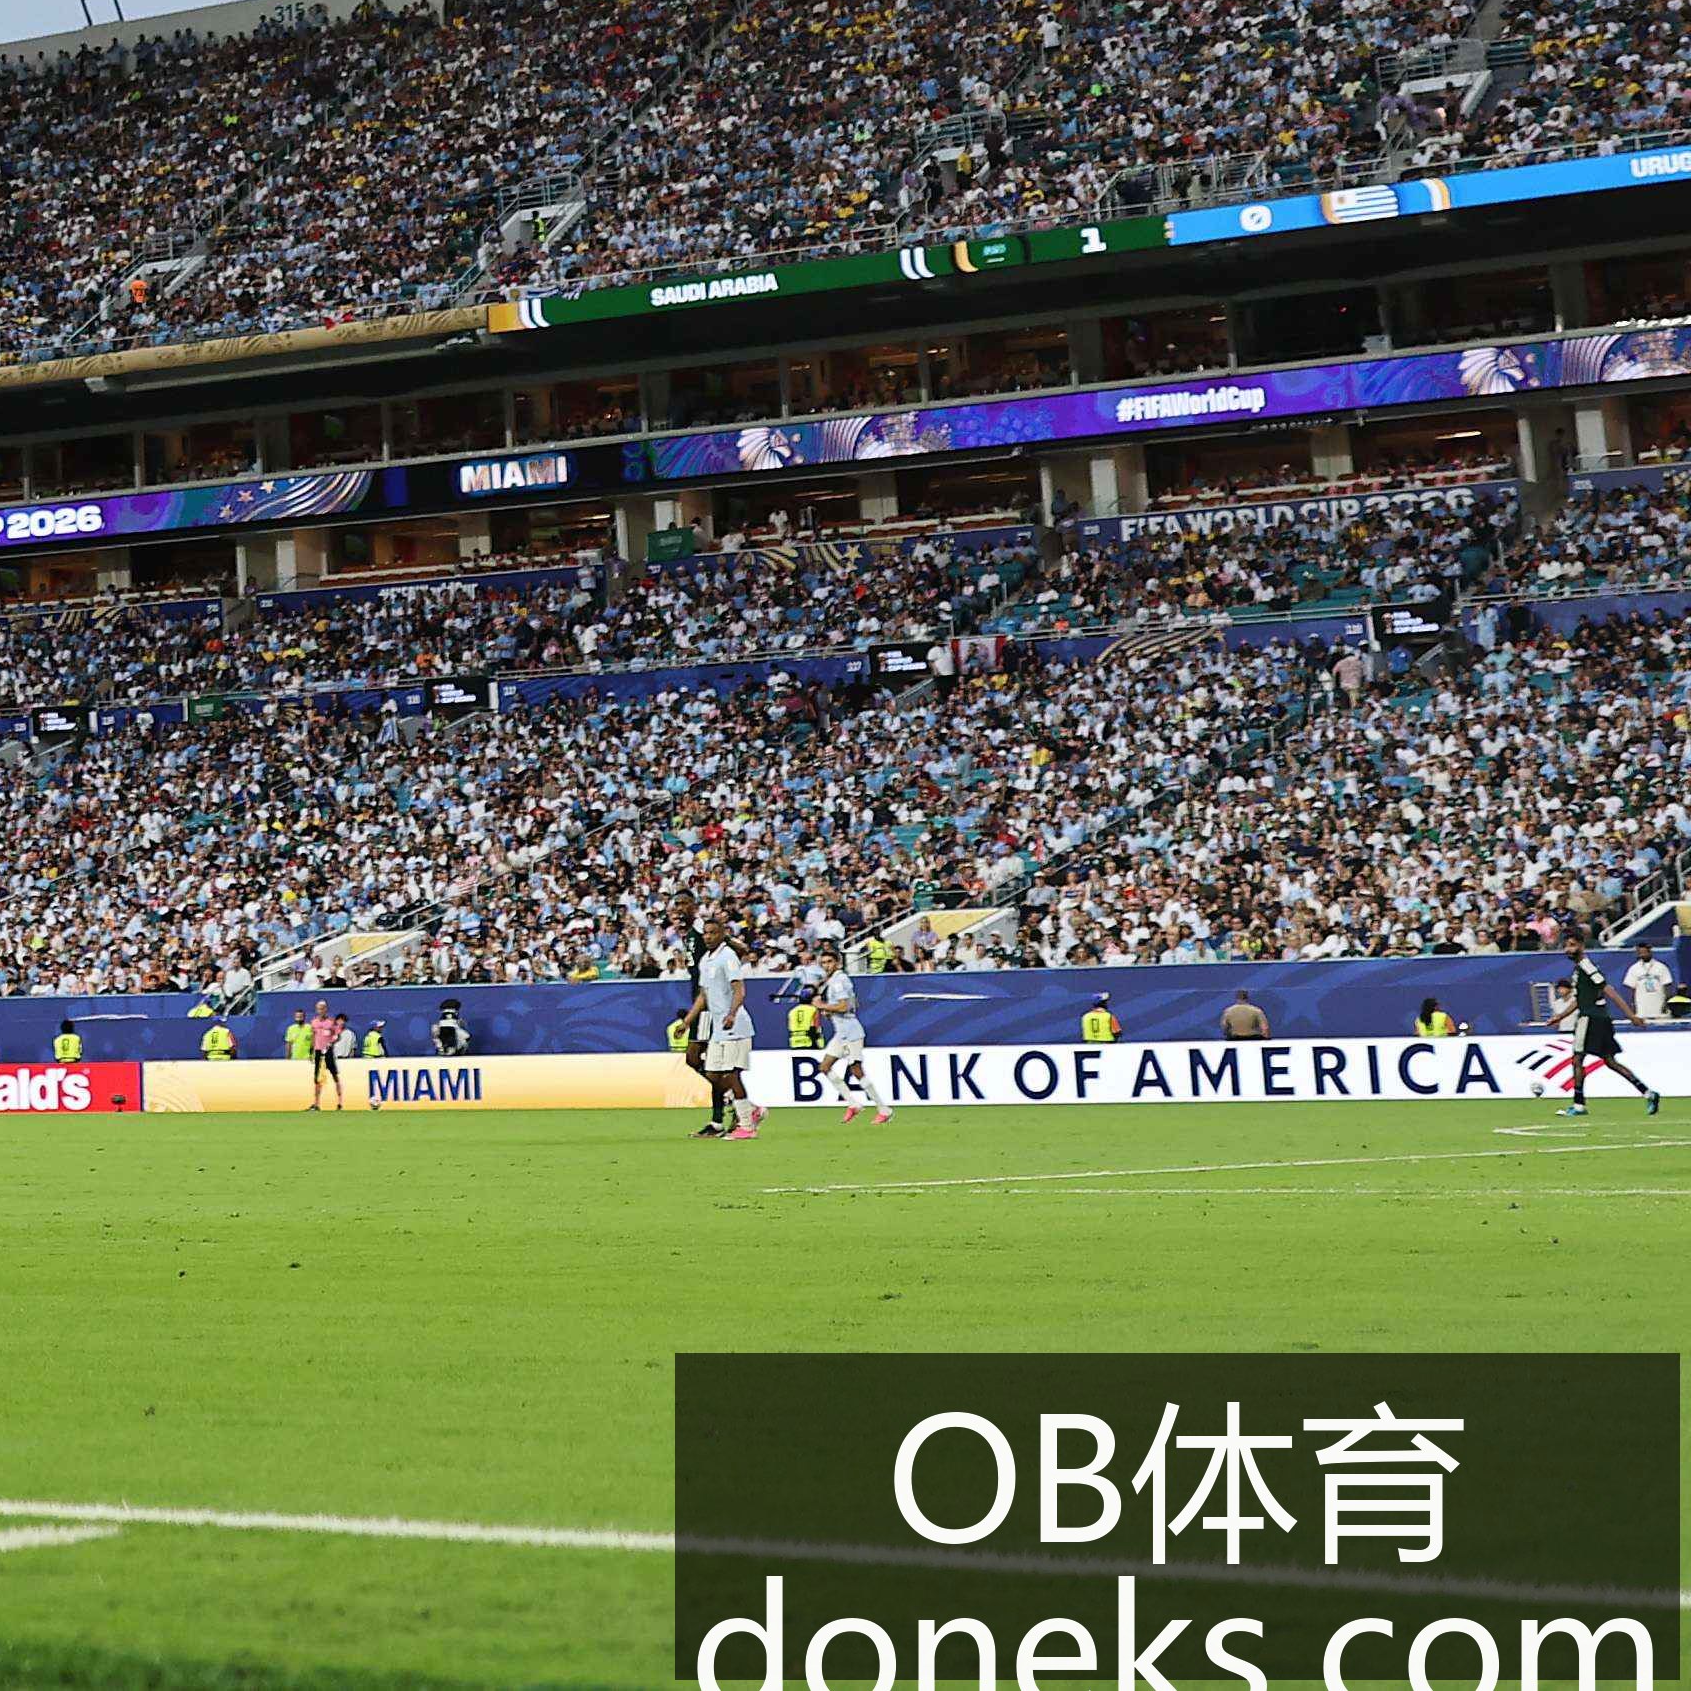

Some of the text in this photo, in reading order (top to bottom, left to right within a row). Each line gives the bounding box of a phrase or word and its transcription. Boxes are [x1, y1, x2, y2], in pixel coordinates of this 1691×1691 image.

[1080, 227, 1107, 254] 1
[650, 272, 779, 308] SAUDI ARABIA
[1115, 386, 1266, 423] #FIFAWorldCup
[460, 455, 569, 494] MIAMI
[7, 504, 101, 540] 2026
[368, 1068, 482, 1102] MIAMI
[1013, 1049, 1103, 1100] OF
[1131, 1042, 1502, 1098] AMERICA
